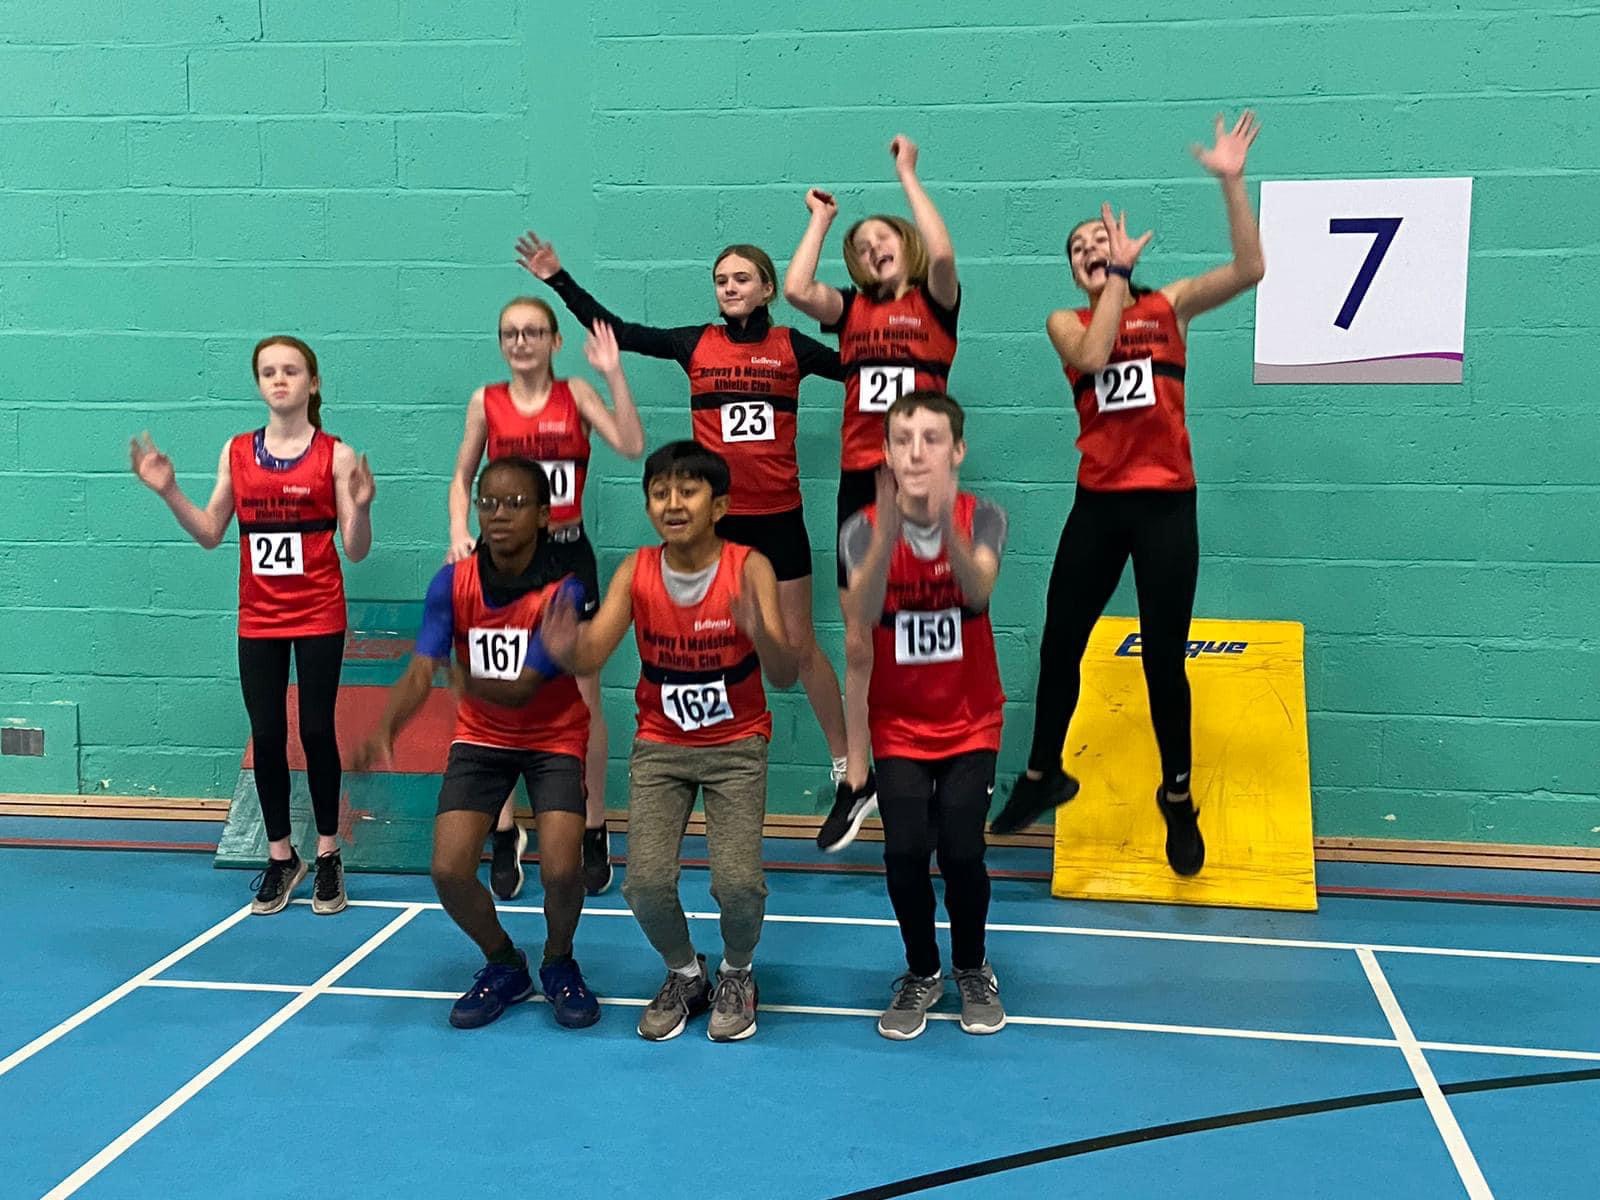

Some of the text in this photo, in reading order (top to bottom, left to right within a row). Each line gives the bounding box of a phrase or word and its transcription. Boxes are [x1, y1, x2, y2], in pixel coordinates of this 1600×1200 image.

[1329, 217, 1404, 330] 7
[714, 379, 771, 392] Athletic Club
[870, 371, 903, 404] 21
[1103, 366, 1146, 404] 22
[729, 404, 767, 436] 23
[549, 462, 568, 498] 0
[257, 537, 295, 569] 24
[476, 633, 520, 673] 161
[902, 616, 955, 656] 159
[666, 687, 727, 724] 162
